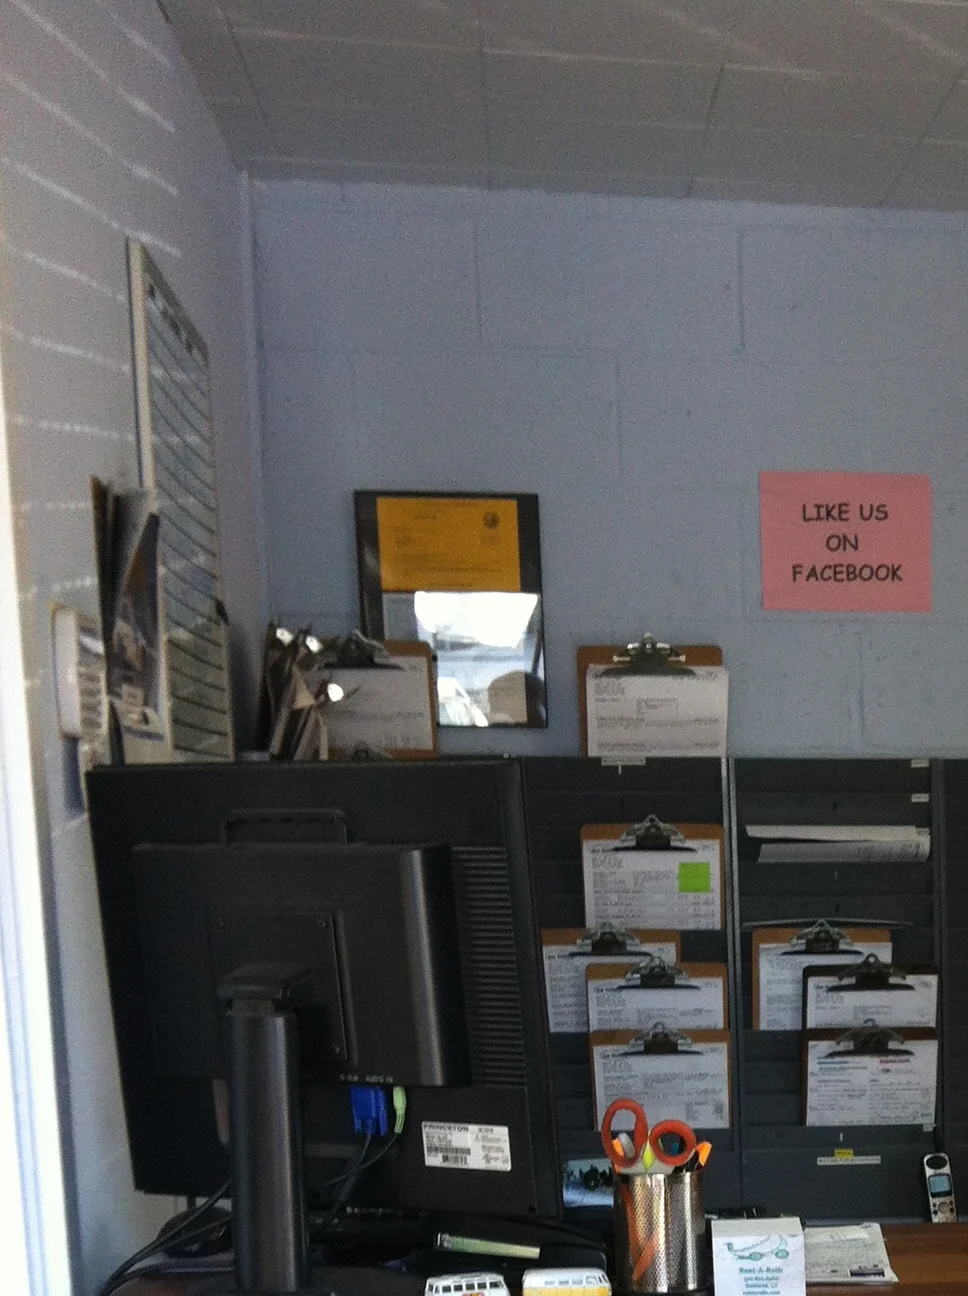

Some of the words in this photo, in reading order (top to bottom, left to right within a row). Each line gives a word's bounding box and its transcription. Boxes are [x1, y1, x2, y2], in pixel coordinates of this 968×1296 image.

[802, 502, 850, 522] LIKE
[859, 503, 889, 521] US
[825, 533, 859, 551] ON
[791, 563, 903, 583] FACEBOOK
